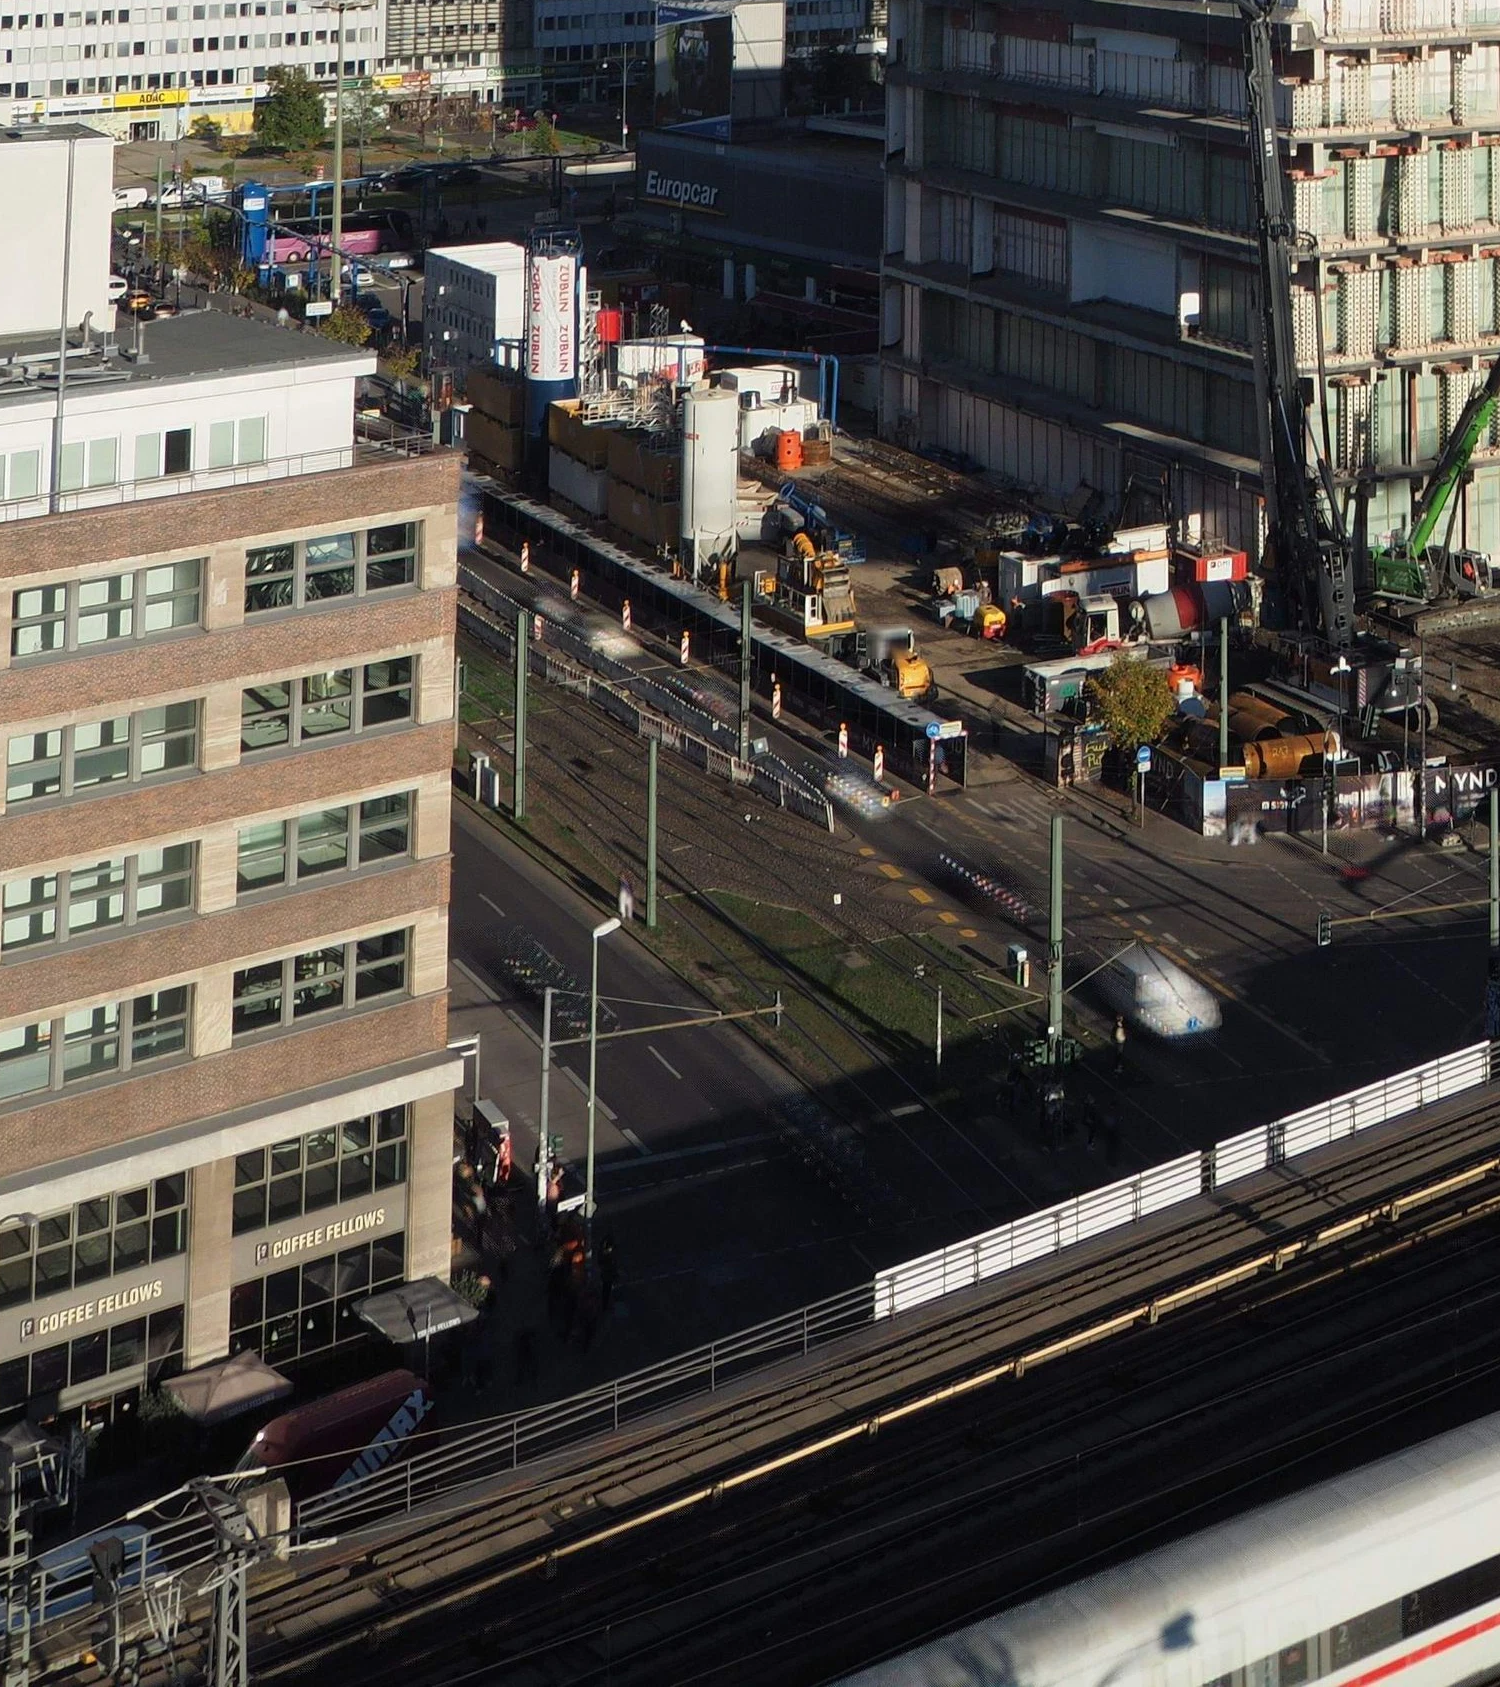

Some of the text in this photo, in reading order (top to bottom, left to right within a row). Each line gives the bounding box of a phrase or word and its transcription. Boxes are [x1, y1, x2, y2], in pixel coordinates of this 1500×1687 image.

[139, 92, 165, 103] ADAC
[645, 169, 718, 207] Europcar
[1434, 768, 1498, 794] MYND
[273, 1208, 386, 1259] COFFEE FELLOWS
[38, 1280, 163, 1335] COFFEE FELLOWS
